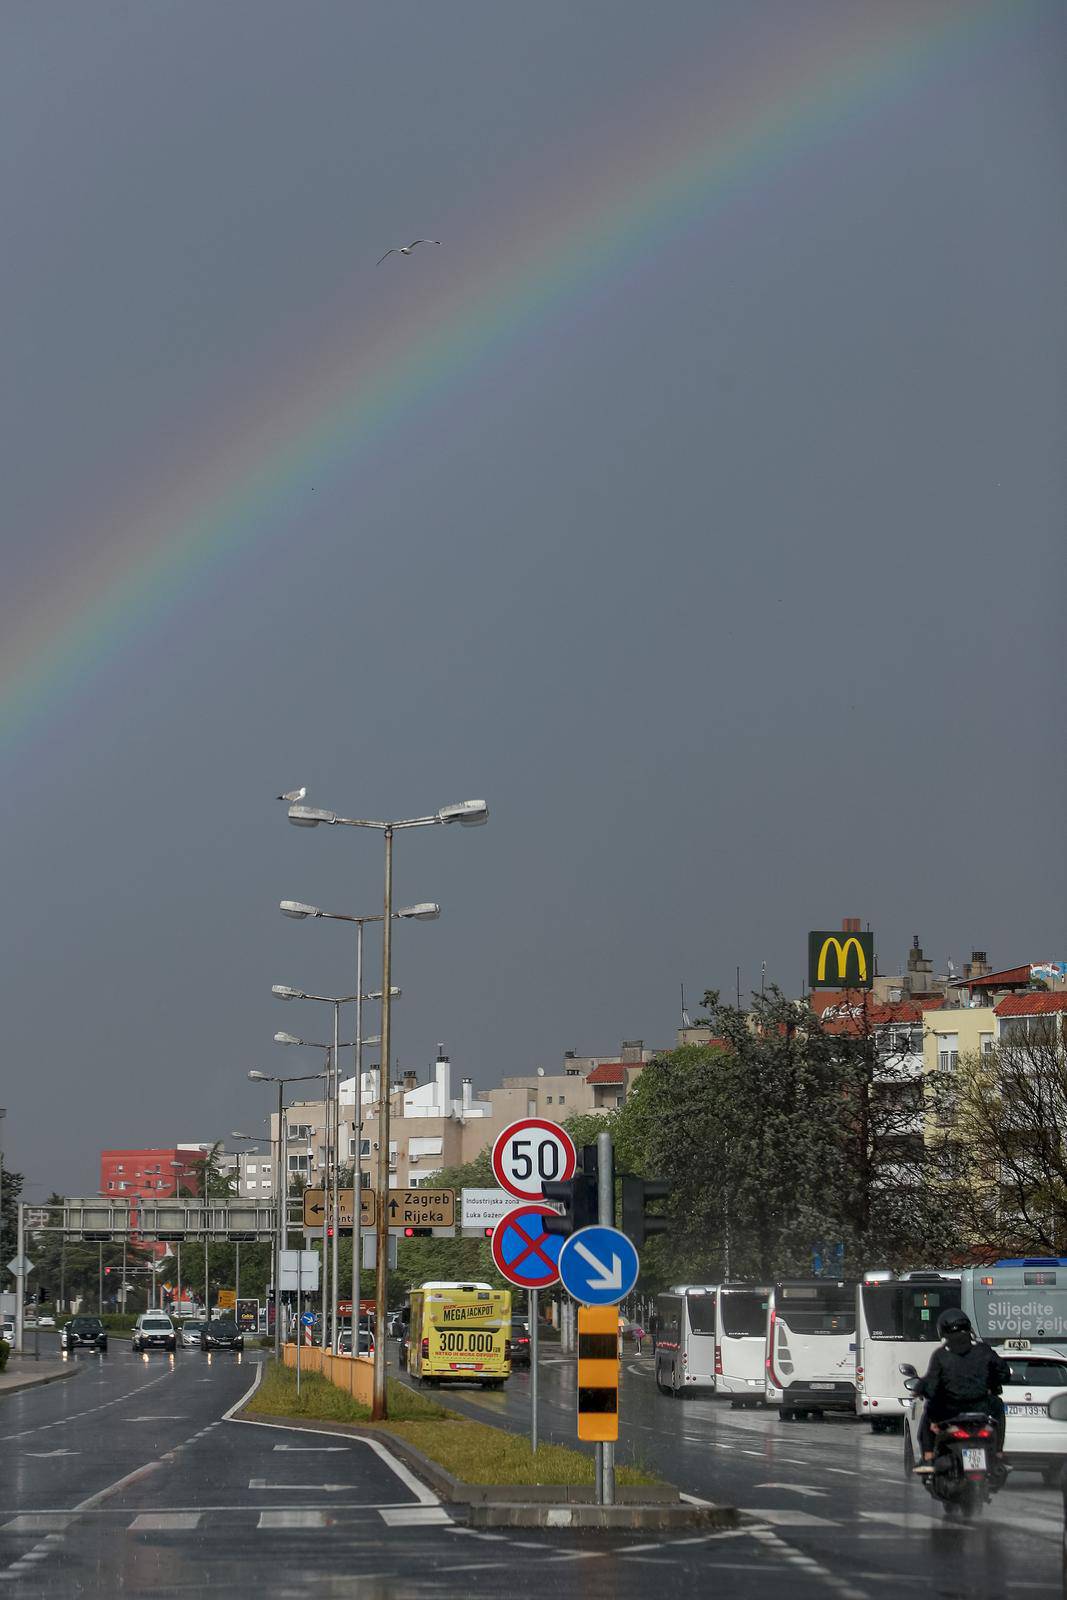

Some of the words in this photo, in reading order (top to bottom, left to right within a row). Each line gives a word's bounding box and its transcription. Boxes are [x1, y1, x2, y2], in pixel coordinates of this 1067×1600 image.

[511, 1140, 559, 1180] 50
[404, 1193, 449, 1207] Zagreb
[404, 1210, 443, 1224] Rijeka
[443, 1308, 466, 1321] MEGA
[466, 1305, 494, 1317] JACKPOT
[988, 1302, 1053, 1319] Slijedite
[988, 1317, 1032, 1334] svoje
[440, 1333, 493, 1352] 300.000
[1024, 1406, 1047, 1415] 139-N
